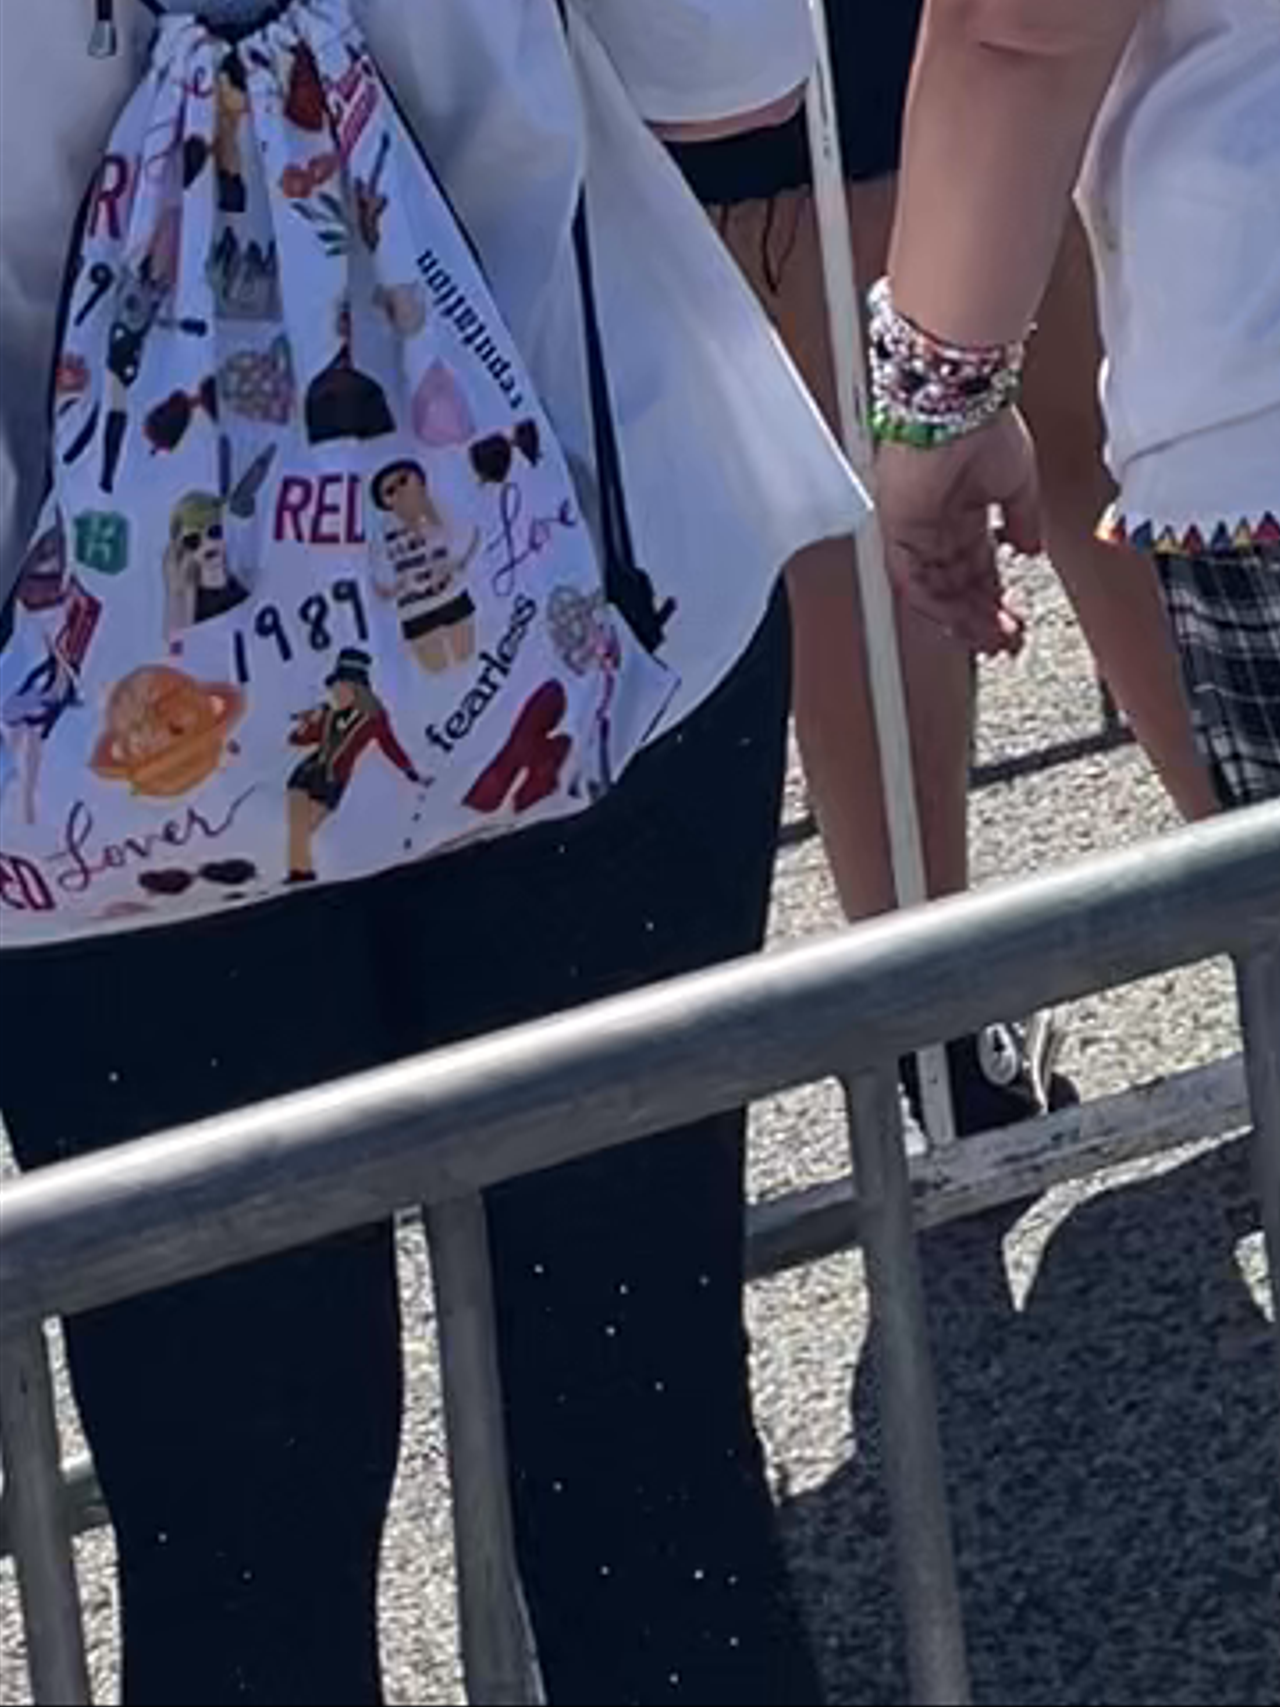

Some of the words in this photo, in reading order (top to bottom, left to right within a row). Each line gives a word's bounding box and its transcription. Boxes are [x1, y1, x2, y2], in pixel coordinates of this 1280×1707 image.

[231, 577, 370, 684] 1989
[424, 592, 537, 754] fearless
[44, 782, 256, 893] Lover
